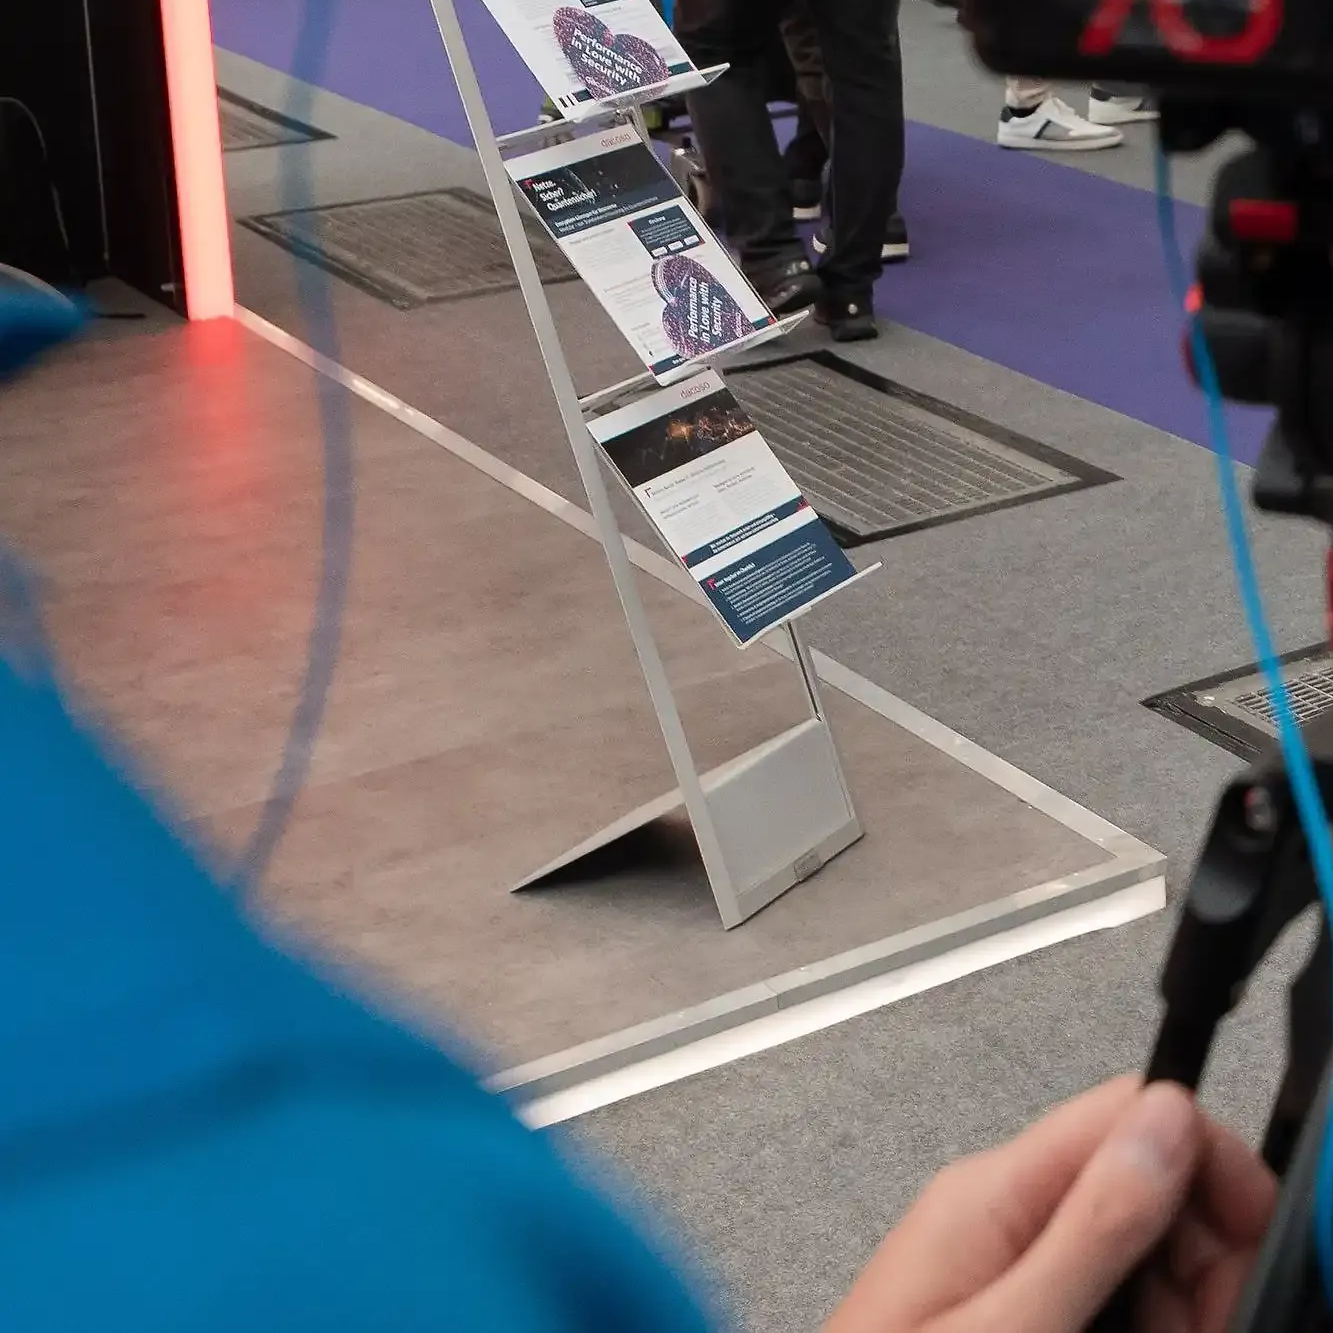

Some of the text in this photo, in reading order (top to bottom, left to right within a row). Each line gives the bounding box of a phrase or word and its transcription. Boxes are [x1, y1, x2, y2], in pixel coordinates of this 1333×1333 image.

[571, 36, 641, 84] in Love with
[573, 27, 643, 74] Performance
[581, 53, 627, 86] Security
[687, 276, 698, 339] Performance
[699, 282, 711, 344] in Love with
[711, 296, 723, 337] Security
